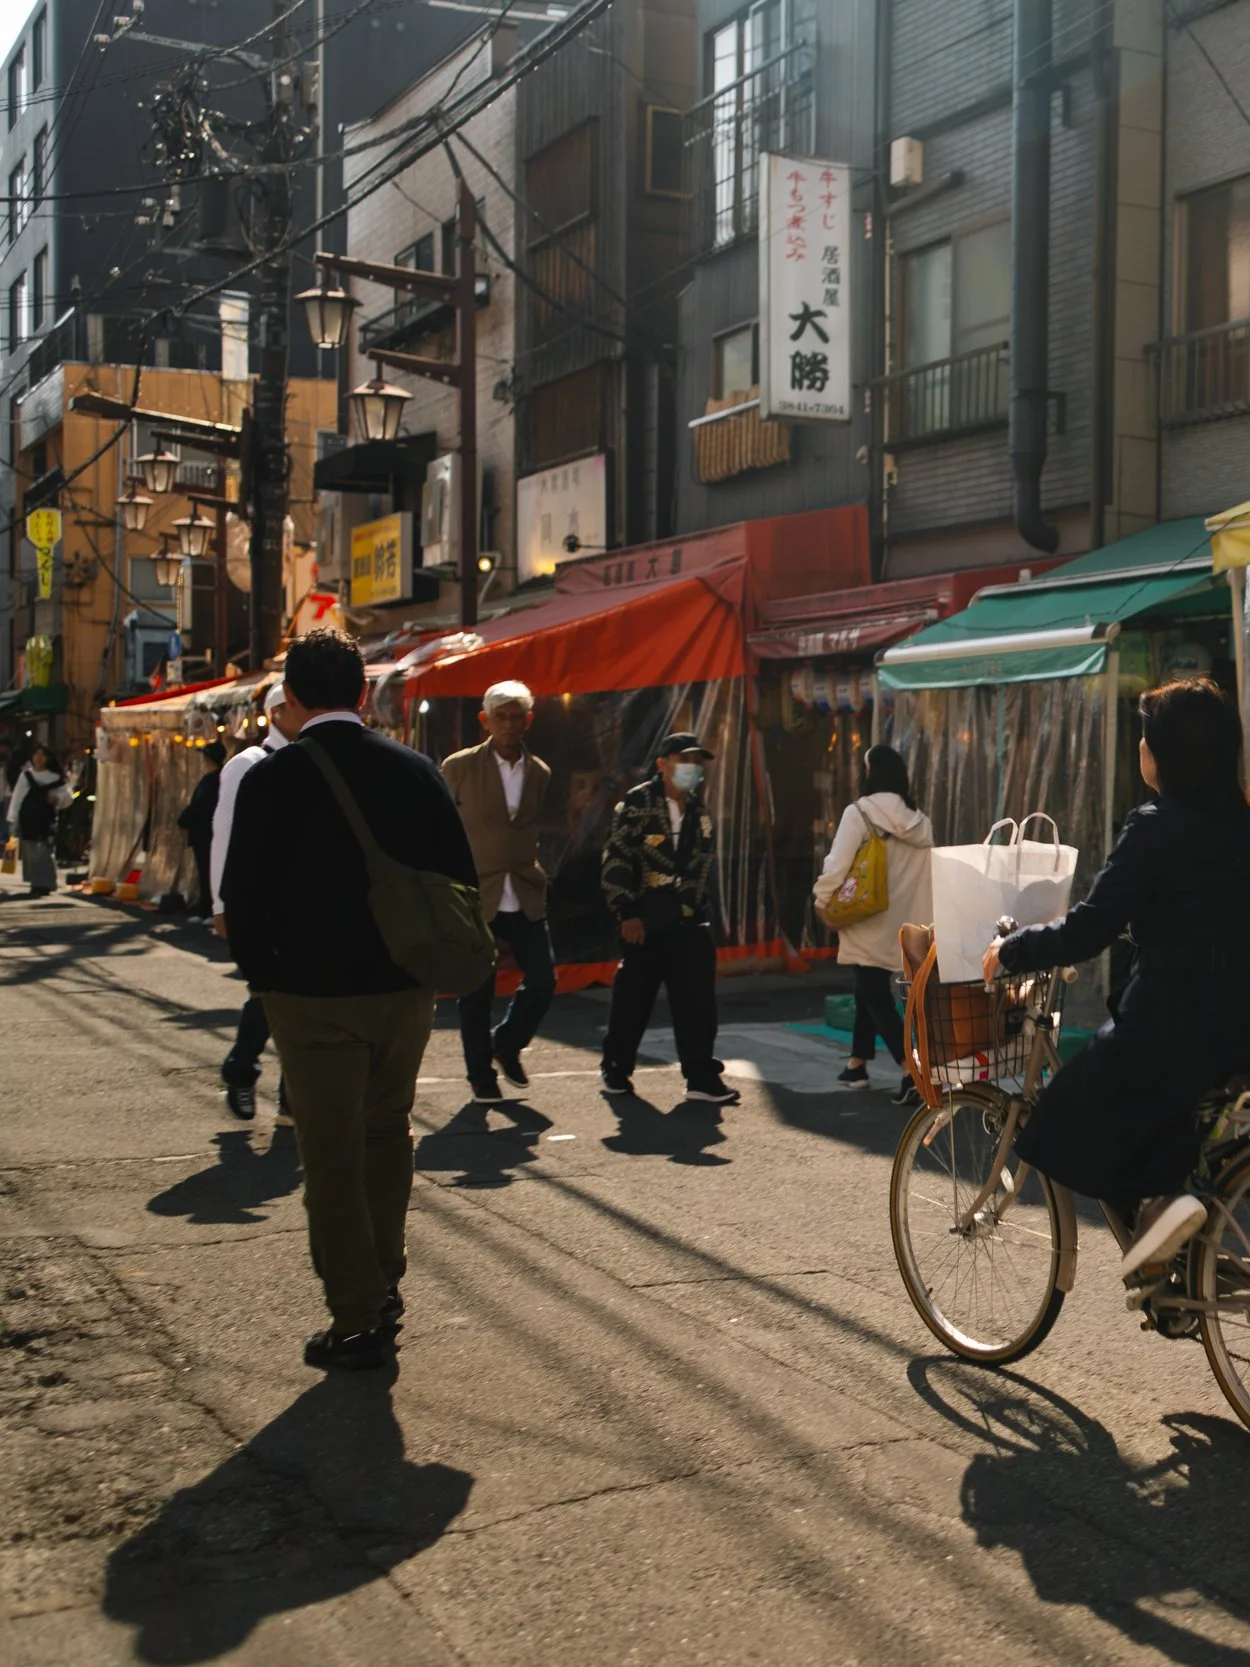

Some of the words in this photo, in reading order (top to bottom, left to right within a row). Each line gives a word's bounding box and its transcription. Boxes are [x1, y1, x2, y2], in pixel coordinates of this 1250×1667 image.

[819, 168, 838, 230] 牛すじ
[821, 245, 841, 307] 居酒屋
[788, 300, 830, 393] 大勝
